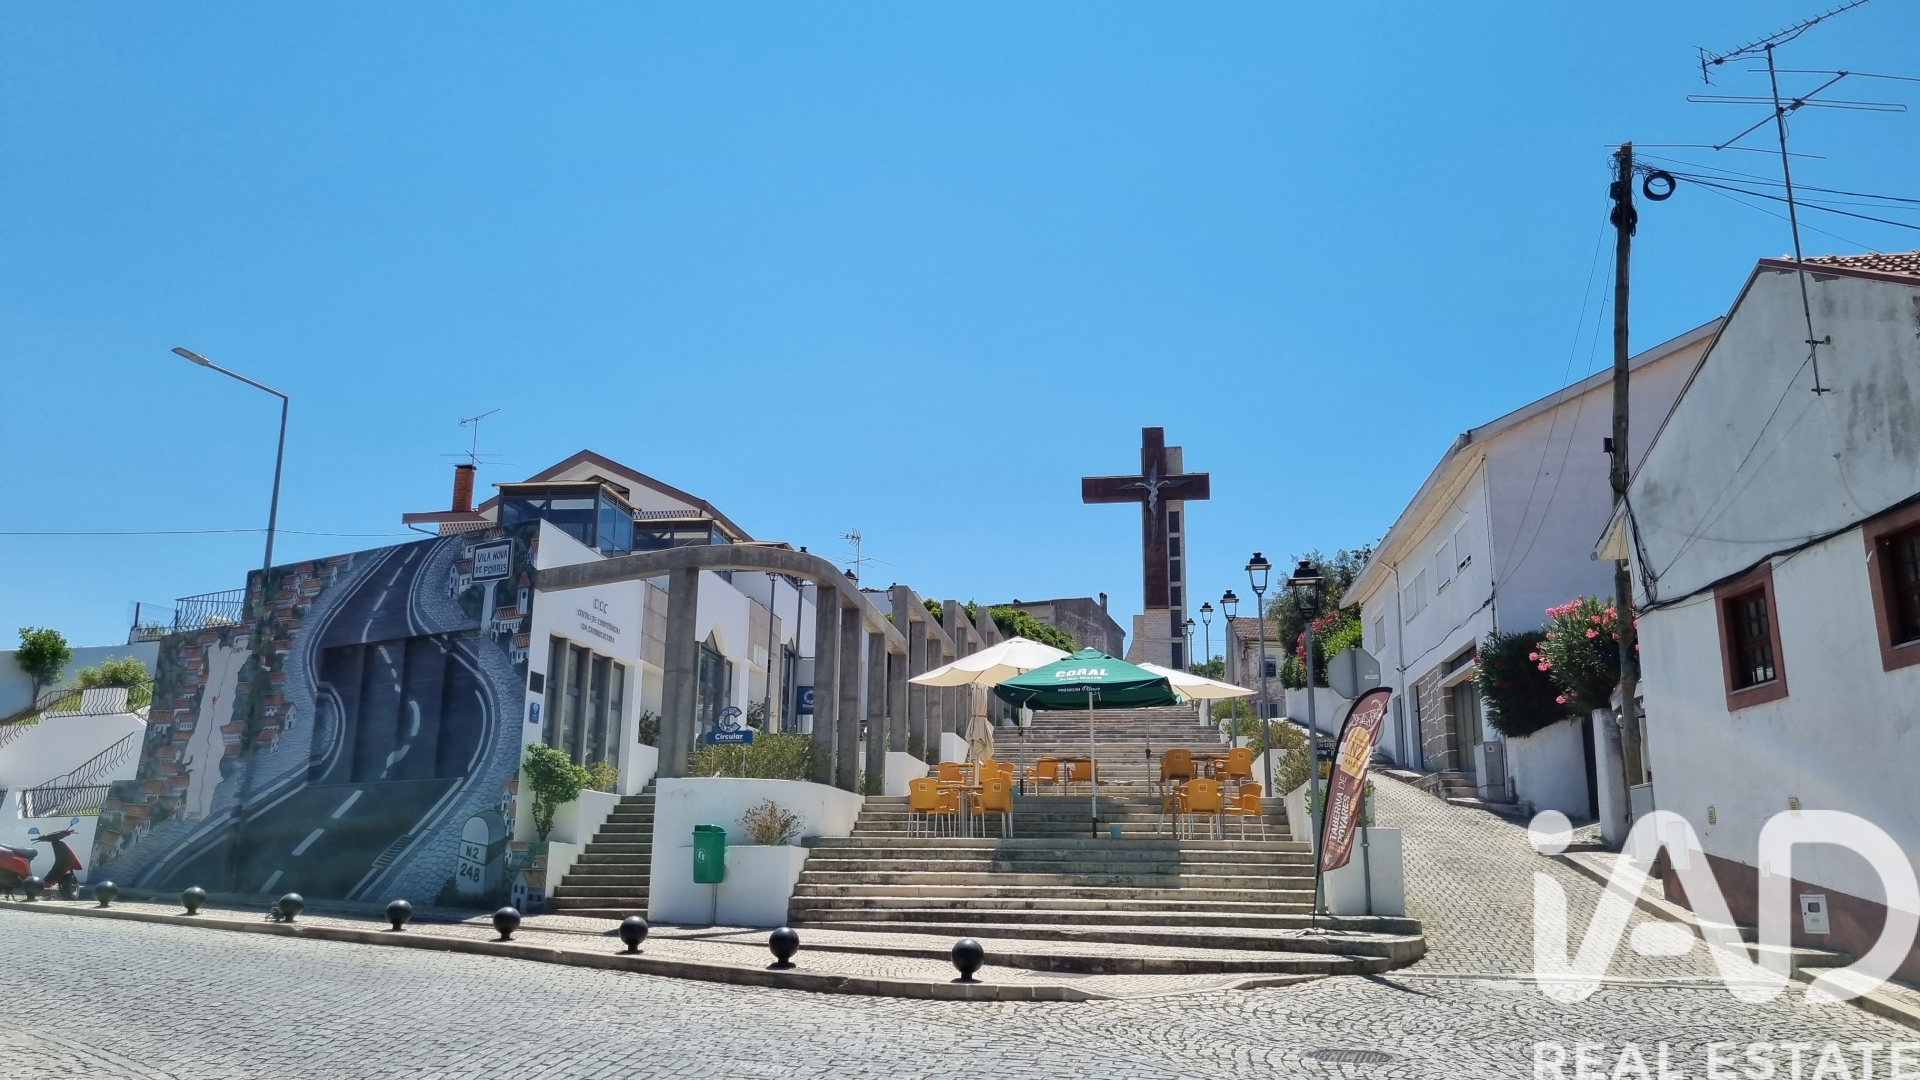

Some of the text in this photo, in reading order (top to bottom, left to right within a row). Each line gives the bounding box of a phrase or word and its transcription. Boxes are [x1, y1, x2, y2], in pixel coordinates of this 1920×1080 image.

[477, 550, 508, 562] VILA NOVA
[1055, 668, 1108, 678] CORAL
[1329, 792, 1343, 840] TABERNA
[1337, 774, 1347, 790] DE
[1337, 794, 1350, 844] POYARES
[465, 845, 479, 859] N2
[459, 862, 480, 883] 248
